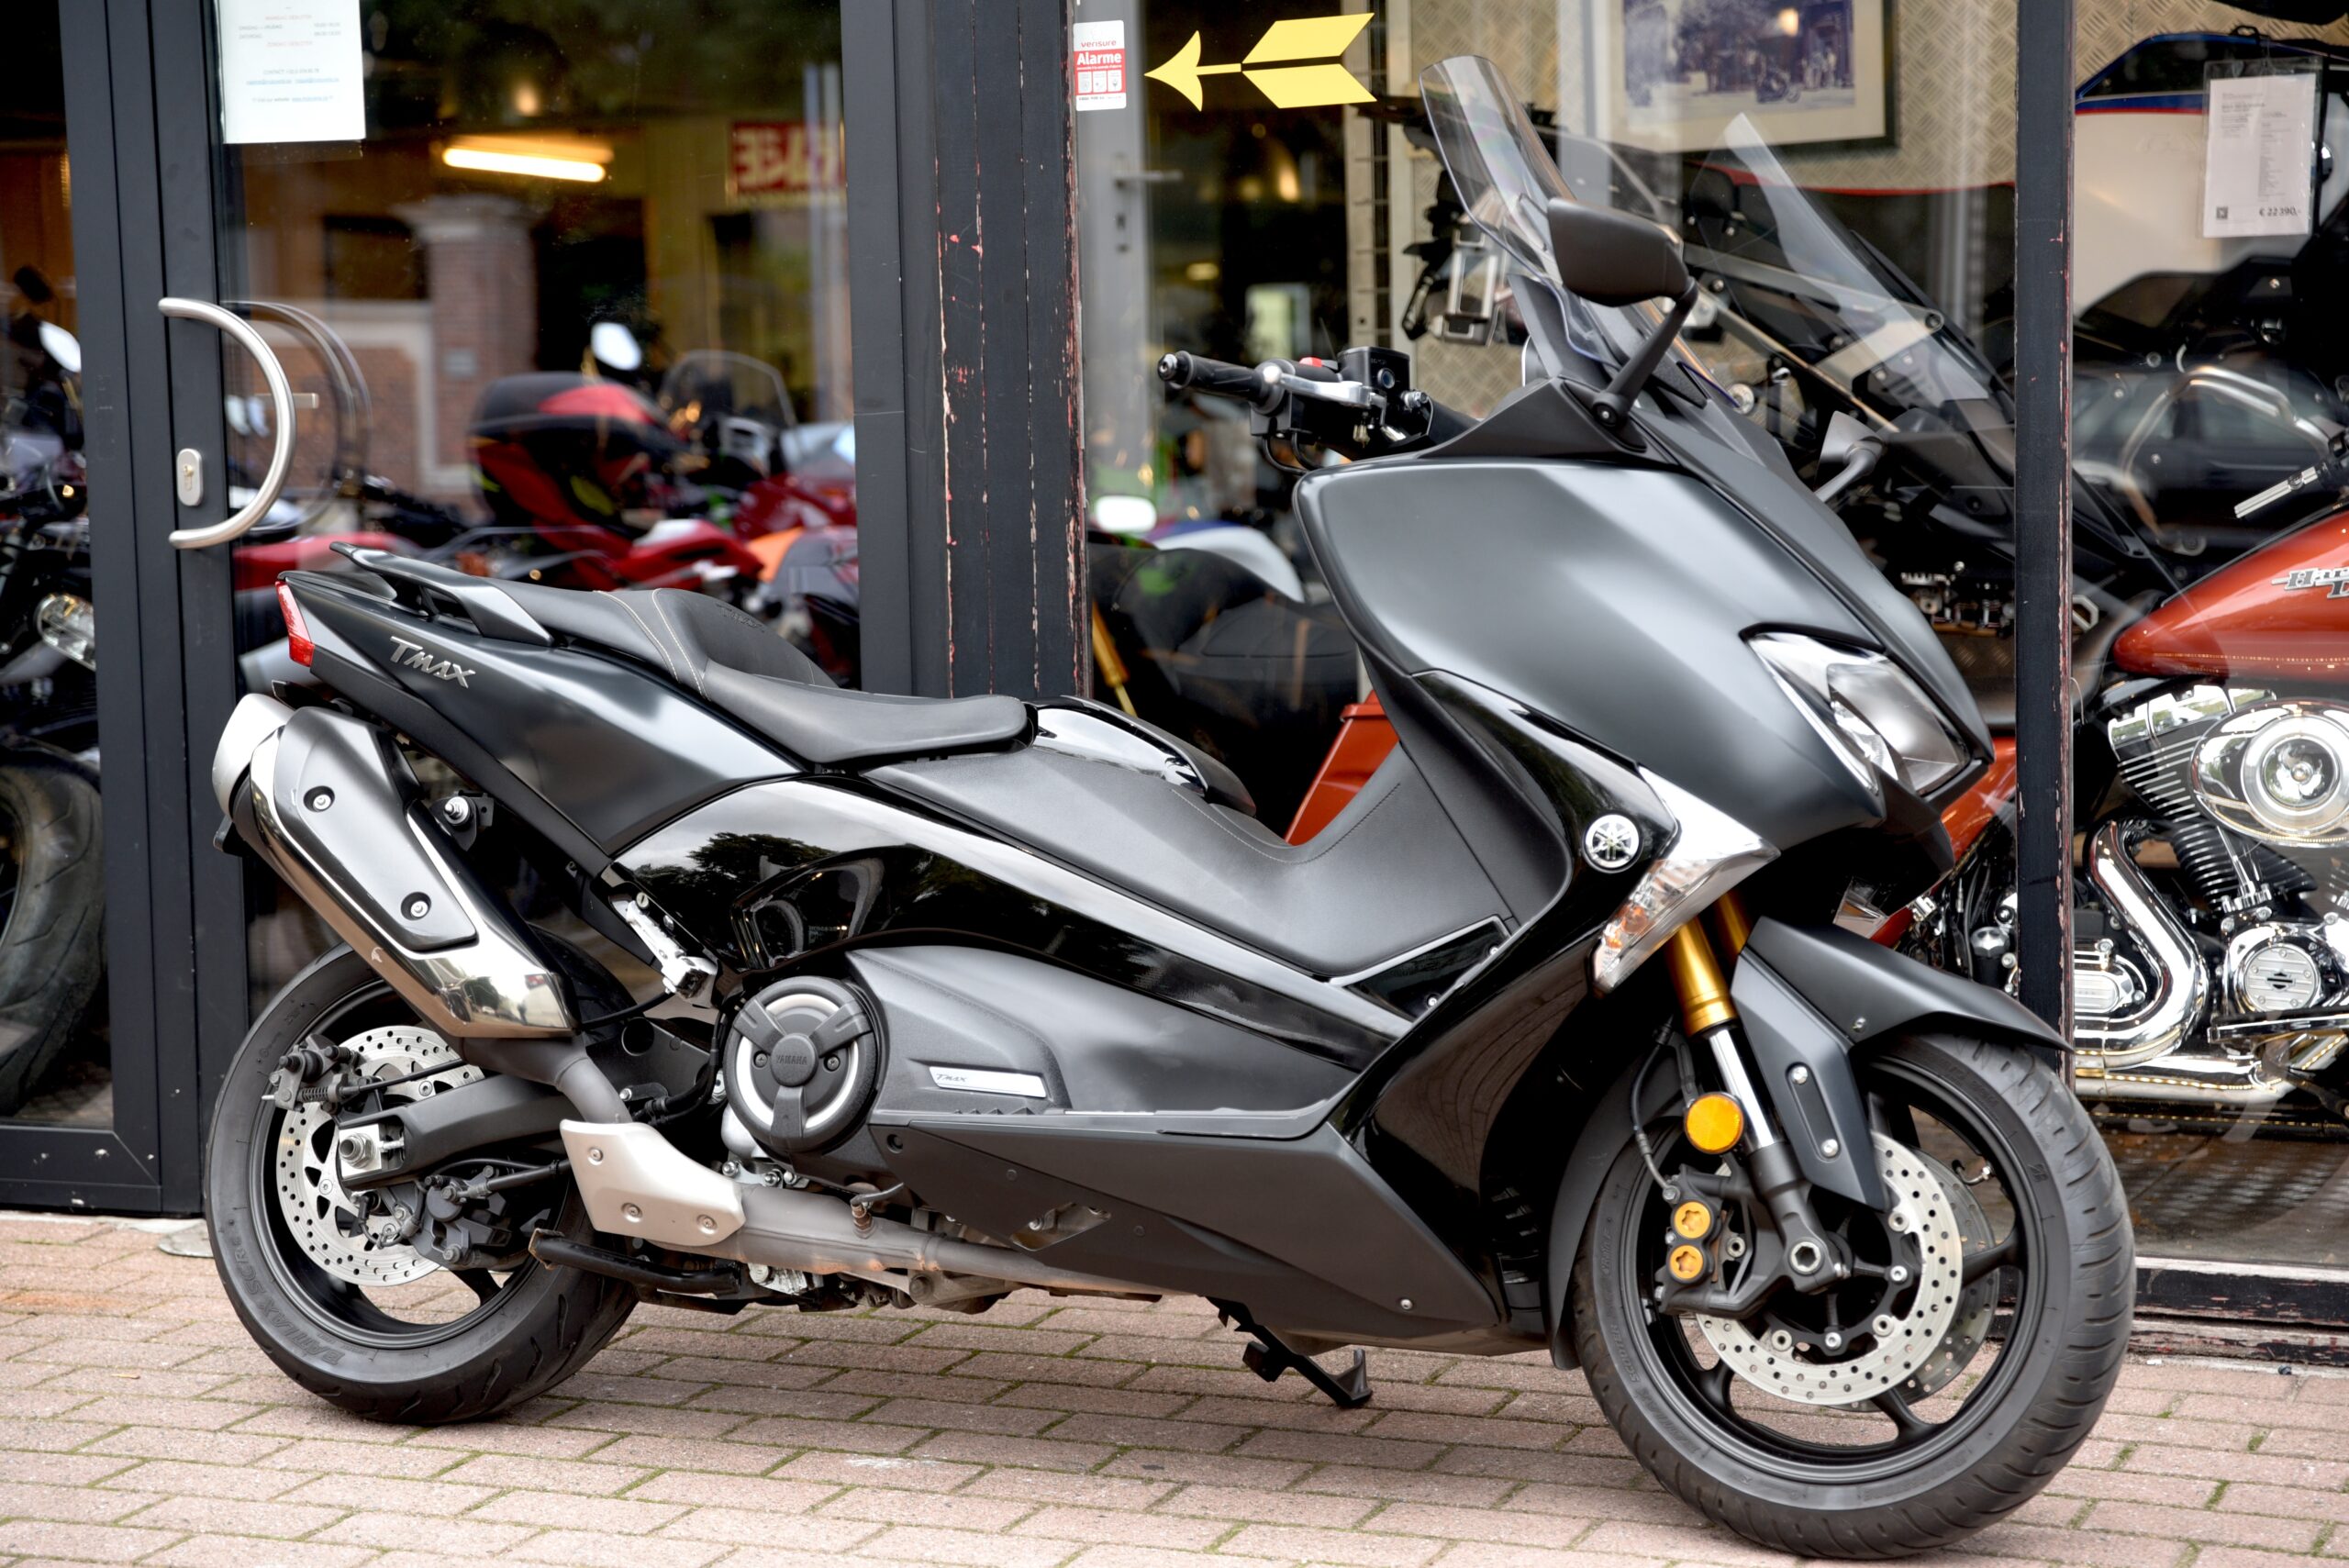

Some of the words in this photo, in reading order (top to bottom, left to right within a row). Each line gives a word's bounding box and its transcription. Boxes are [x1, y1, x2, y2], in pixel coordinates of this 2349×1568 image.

[1081, 39, 1117, 48] verisure
[1076, 51, 1122, 65] Alarme
[390, 635, 476, 689] TMAX
[775, 1054, 808, 1065] YAMAHA
[935, 1073, 969, 1083] TMAX
